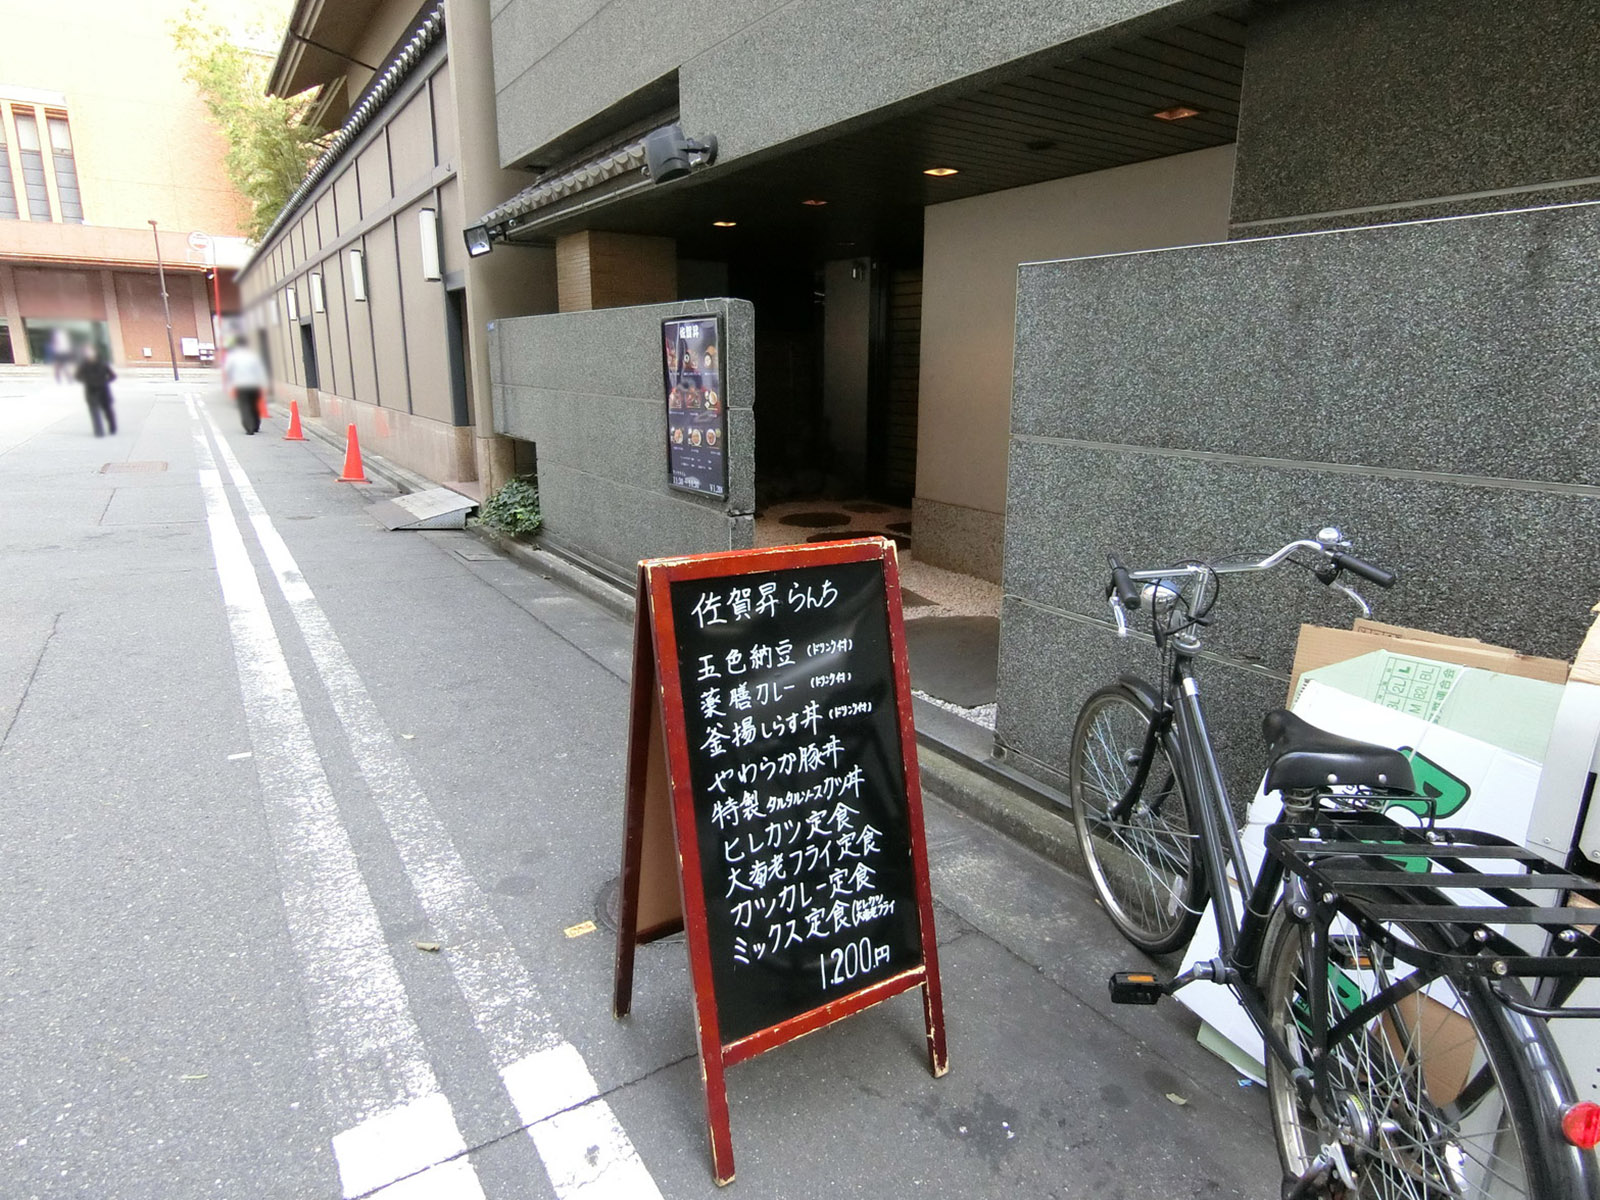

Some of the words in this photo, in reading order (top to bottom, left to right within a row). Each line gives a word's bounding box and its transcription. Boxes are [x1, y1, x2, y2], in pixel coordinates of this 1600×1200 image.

[697, 639, 796, 681] 五色納豆
[1392, 681, 1407, 693] 2L
[700, 682, 795, 718] 薬膳カレー
[1408, 704, 1423, 713] M
[700, 701, 823, 758] 釜揚しらす丼
[708, 735, 845, 793] やわらか豚丼
[725, 801, 860, 862] ヒレカツ定食
[726, 824, 882, 898] 大海老フライ定食
[731, 862, 876, 928] カツカレー定食
[734, 900, 852, 964] ミックス定食
